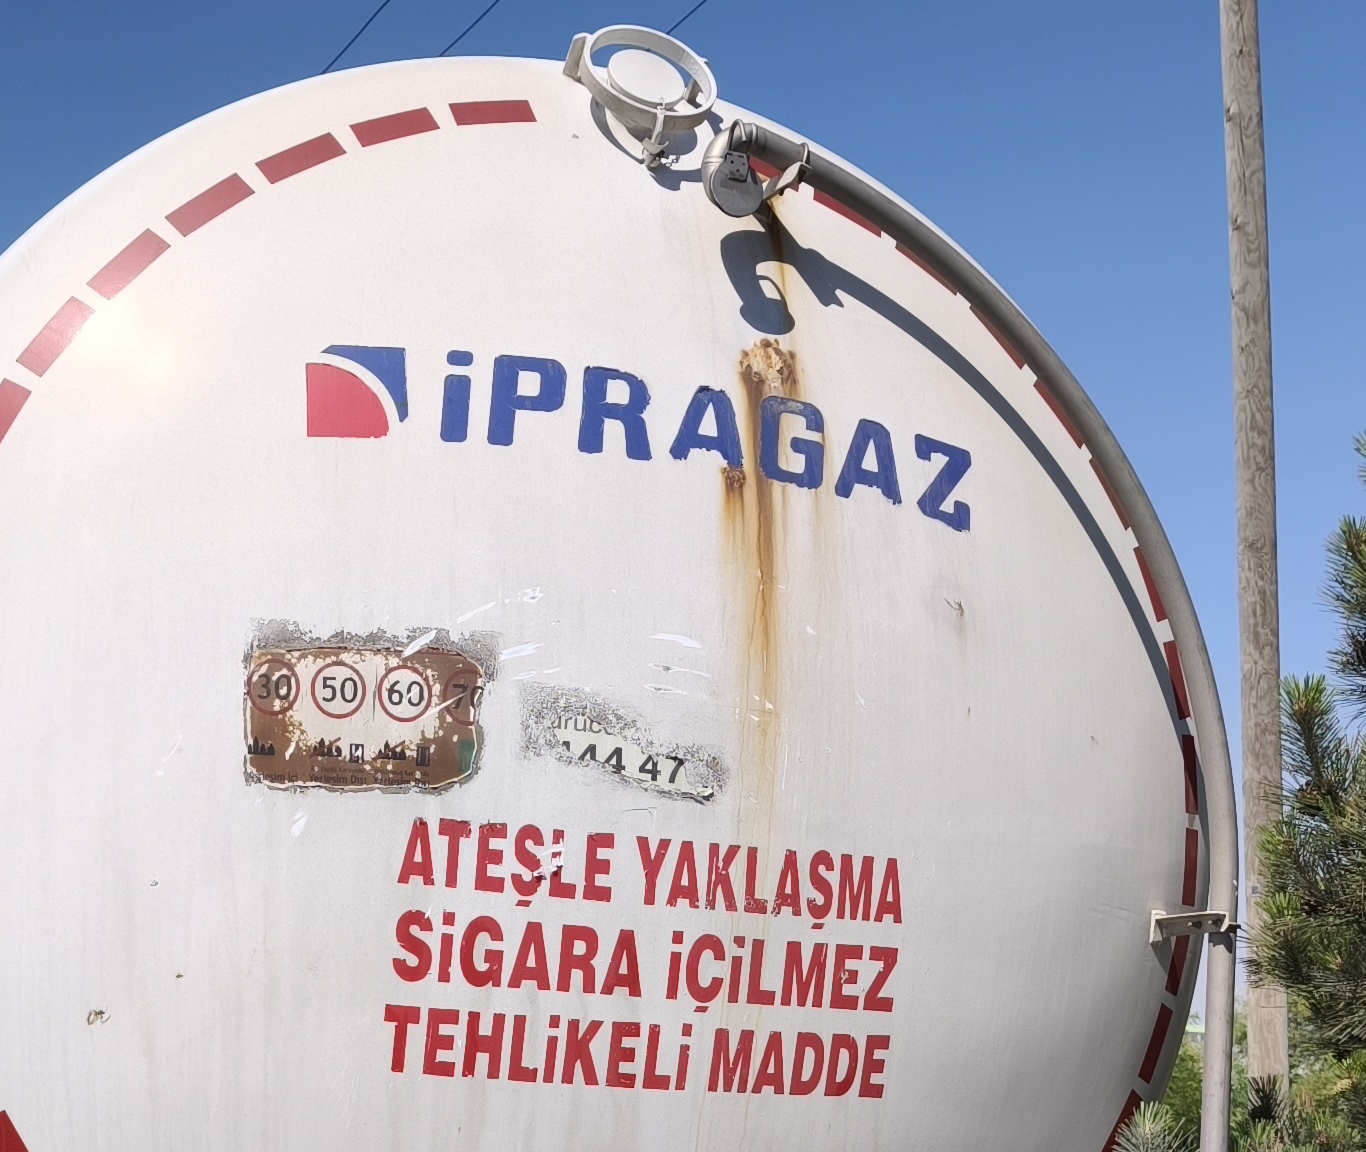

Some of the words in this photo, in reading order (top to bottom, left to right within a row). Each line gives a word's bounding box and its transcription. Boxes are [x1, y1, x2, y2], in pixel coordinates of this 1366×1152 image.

[256, 673, 292, 700] 30
[321, 676, 359, 704] 50
[387, 680, 425, 708] 60
[638, 754, 685, 785] 47
[397, 817, 615, 908] ATEŞLE
[636, 835, 902, 930] YAKLAŞMA
[707, 1027, 891, 1099] MADDE
